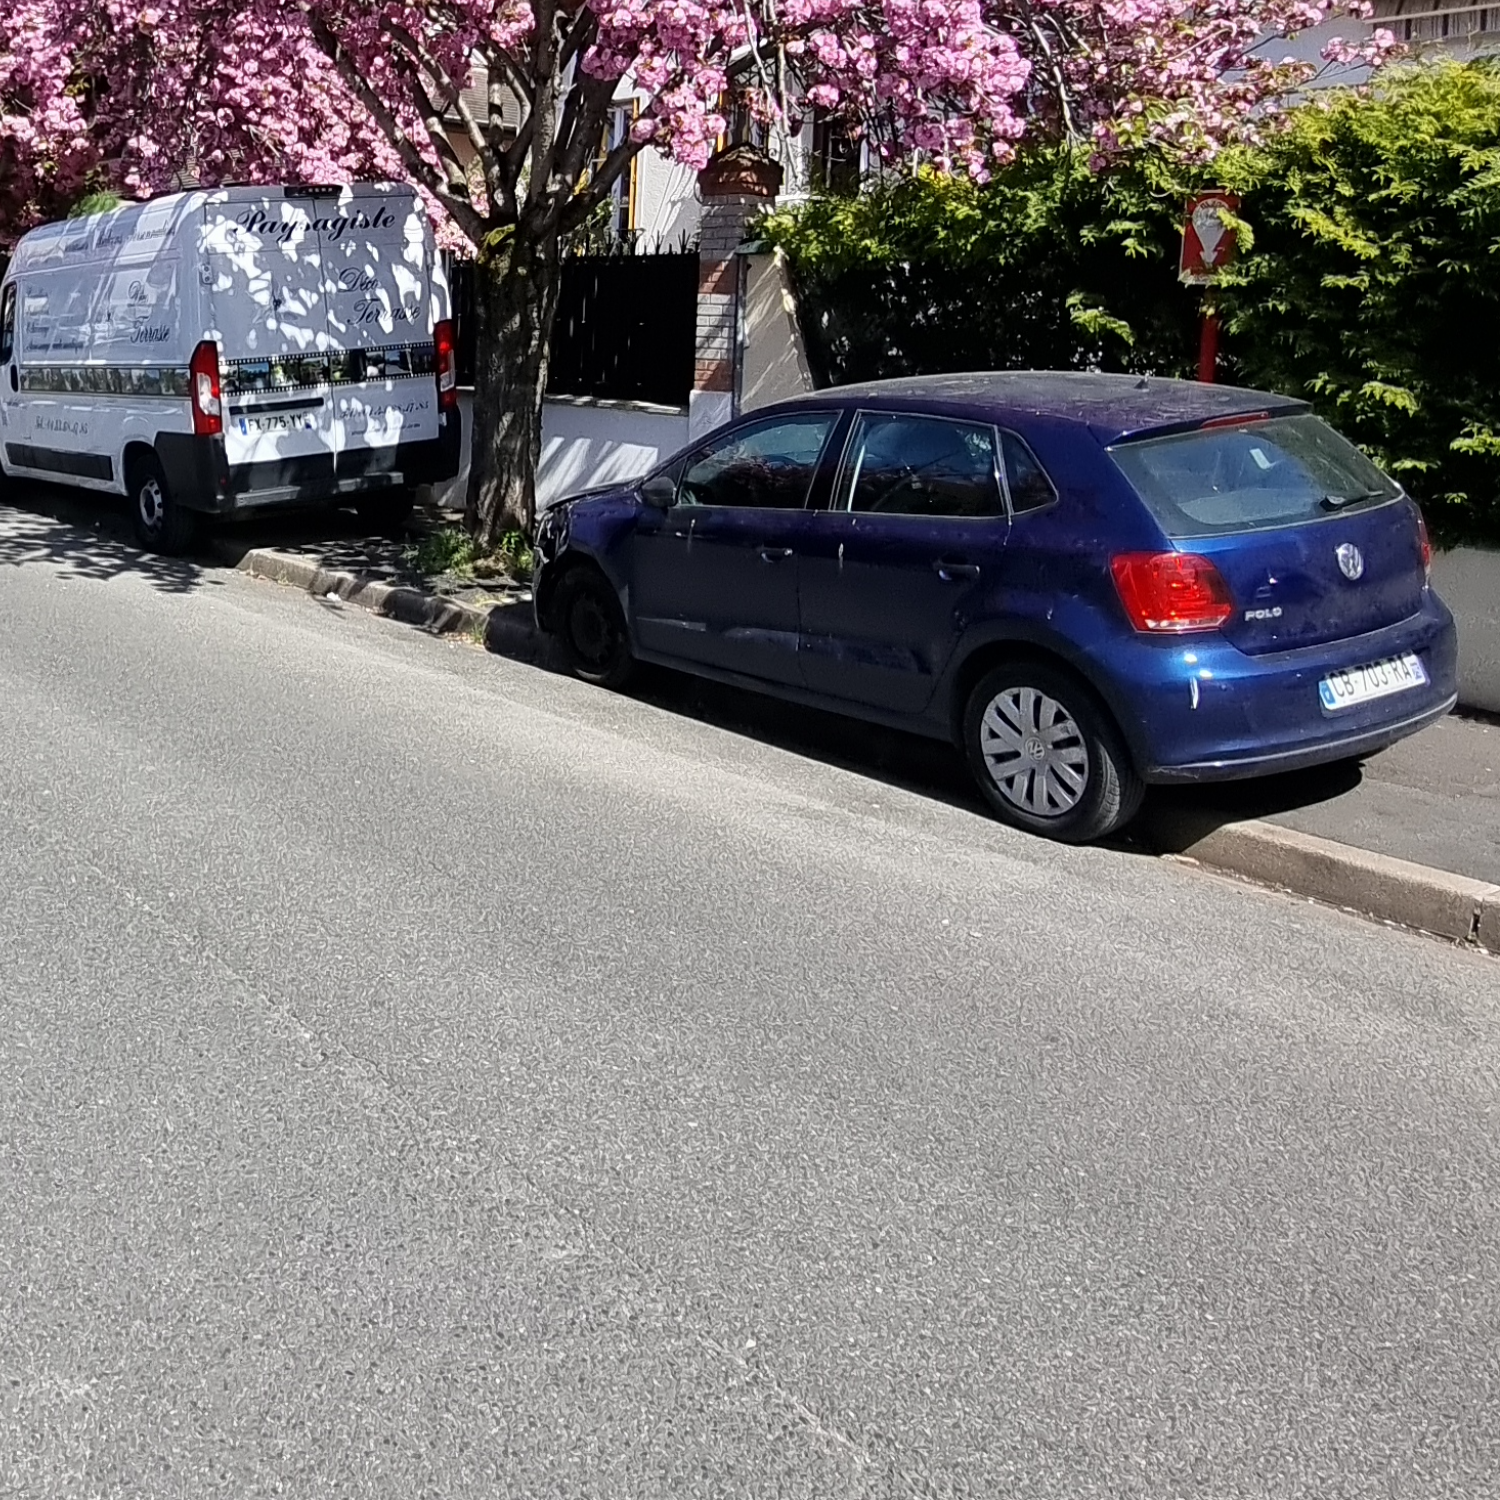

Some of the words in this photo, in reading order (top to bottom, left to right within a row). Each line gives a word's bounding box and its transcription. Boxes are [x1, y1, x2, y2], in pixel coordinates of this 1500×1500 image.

[233, 207, 396, 242] Paysagiste
[1244, 606, 1283, 622] POLO
[1329, 654, 1413, 698] CB-703-RA
